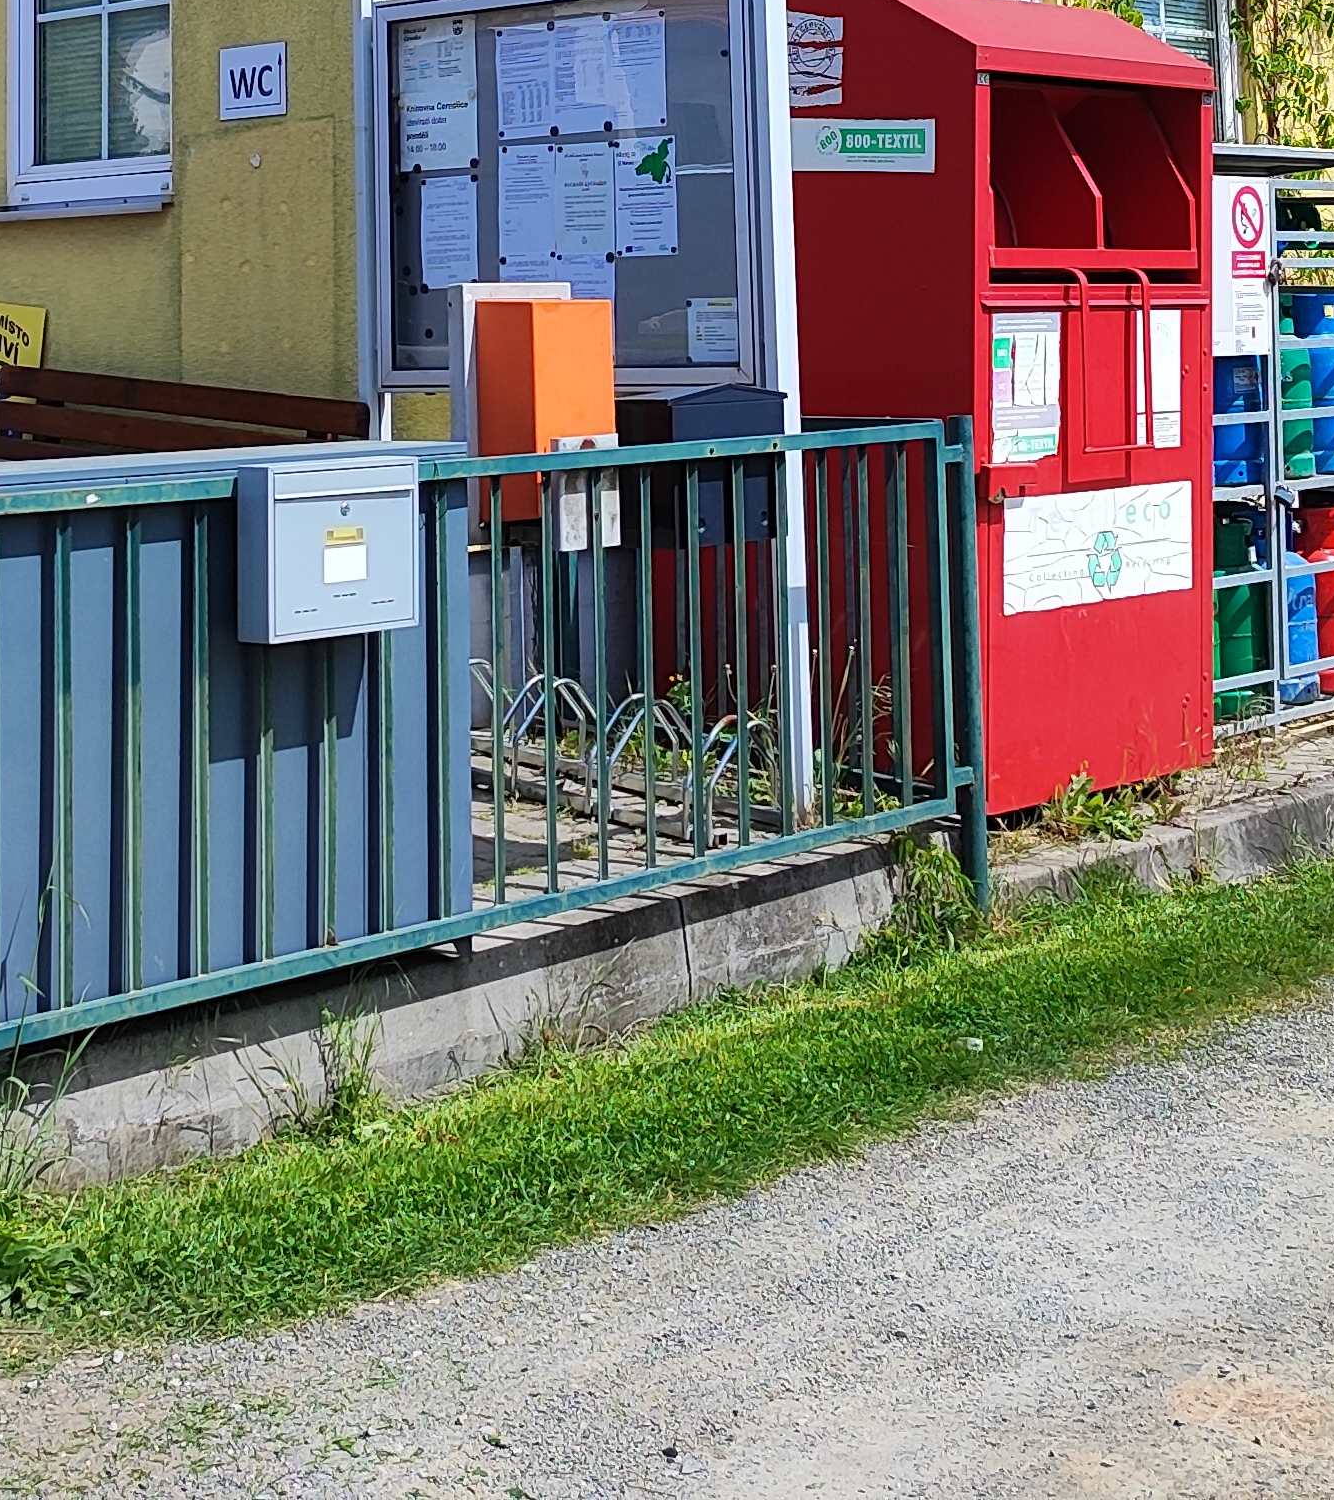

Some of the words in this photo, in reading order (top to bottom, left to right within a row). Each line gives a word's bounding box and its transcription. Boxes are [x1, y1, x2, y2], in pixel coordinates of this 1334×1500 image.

[229, 64, 273, 100] WC
[820, 130, 838, 150] 800
[846, 133, 922, 149] 800-TEXTIL
[1124, 500, 1172, 525] eco
[1029, 569, 1085, 583] Collecting
